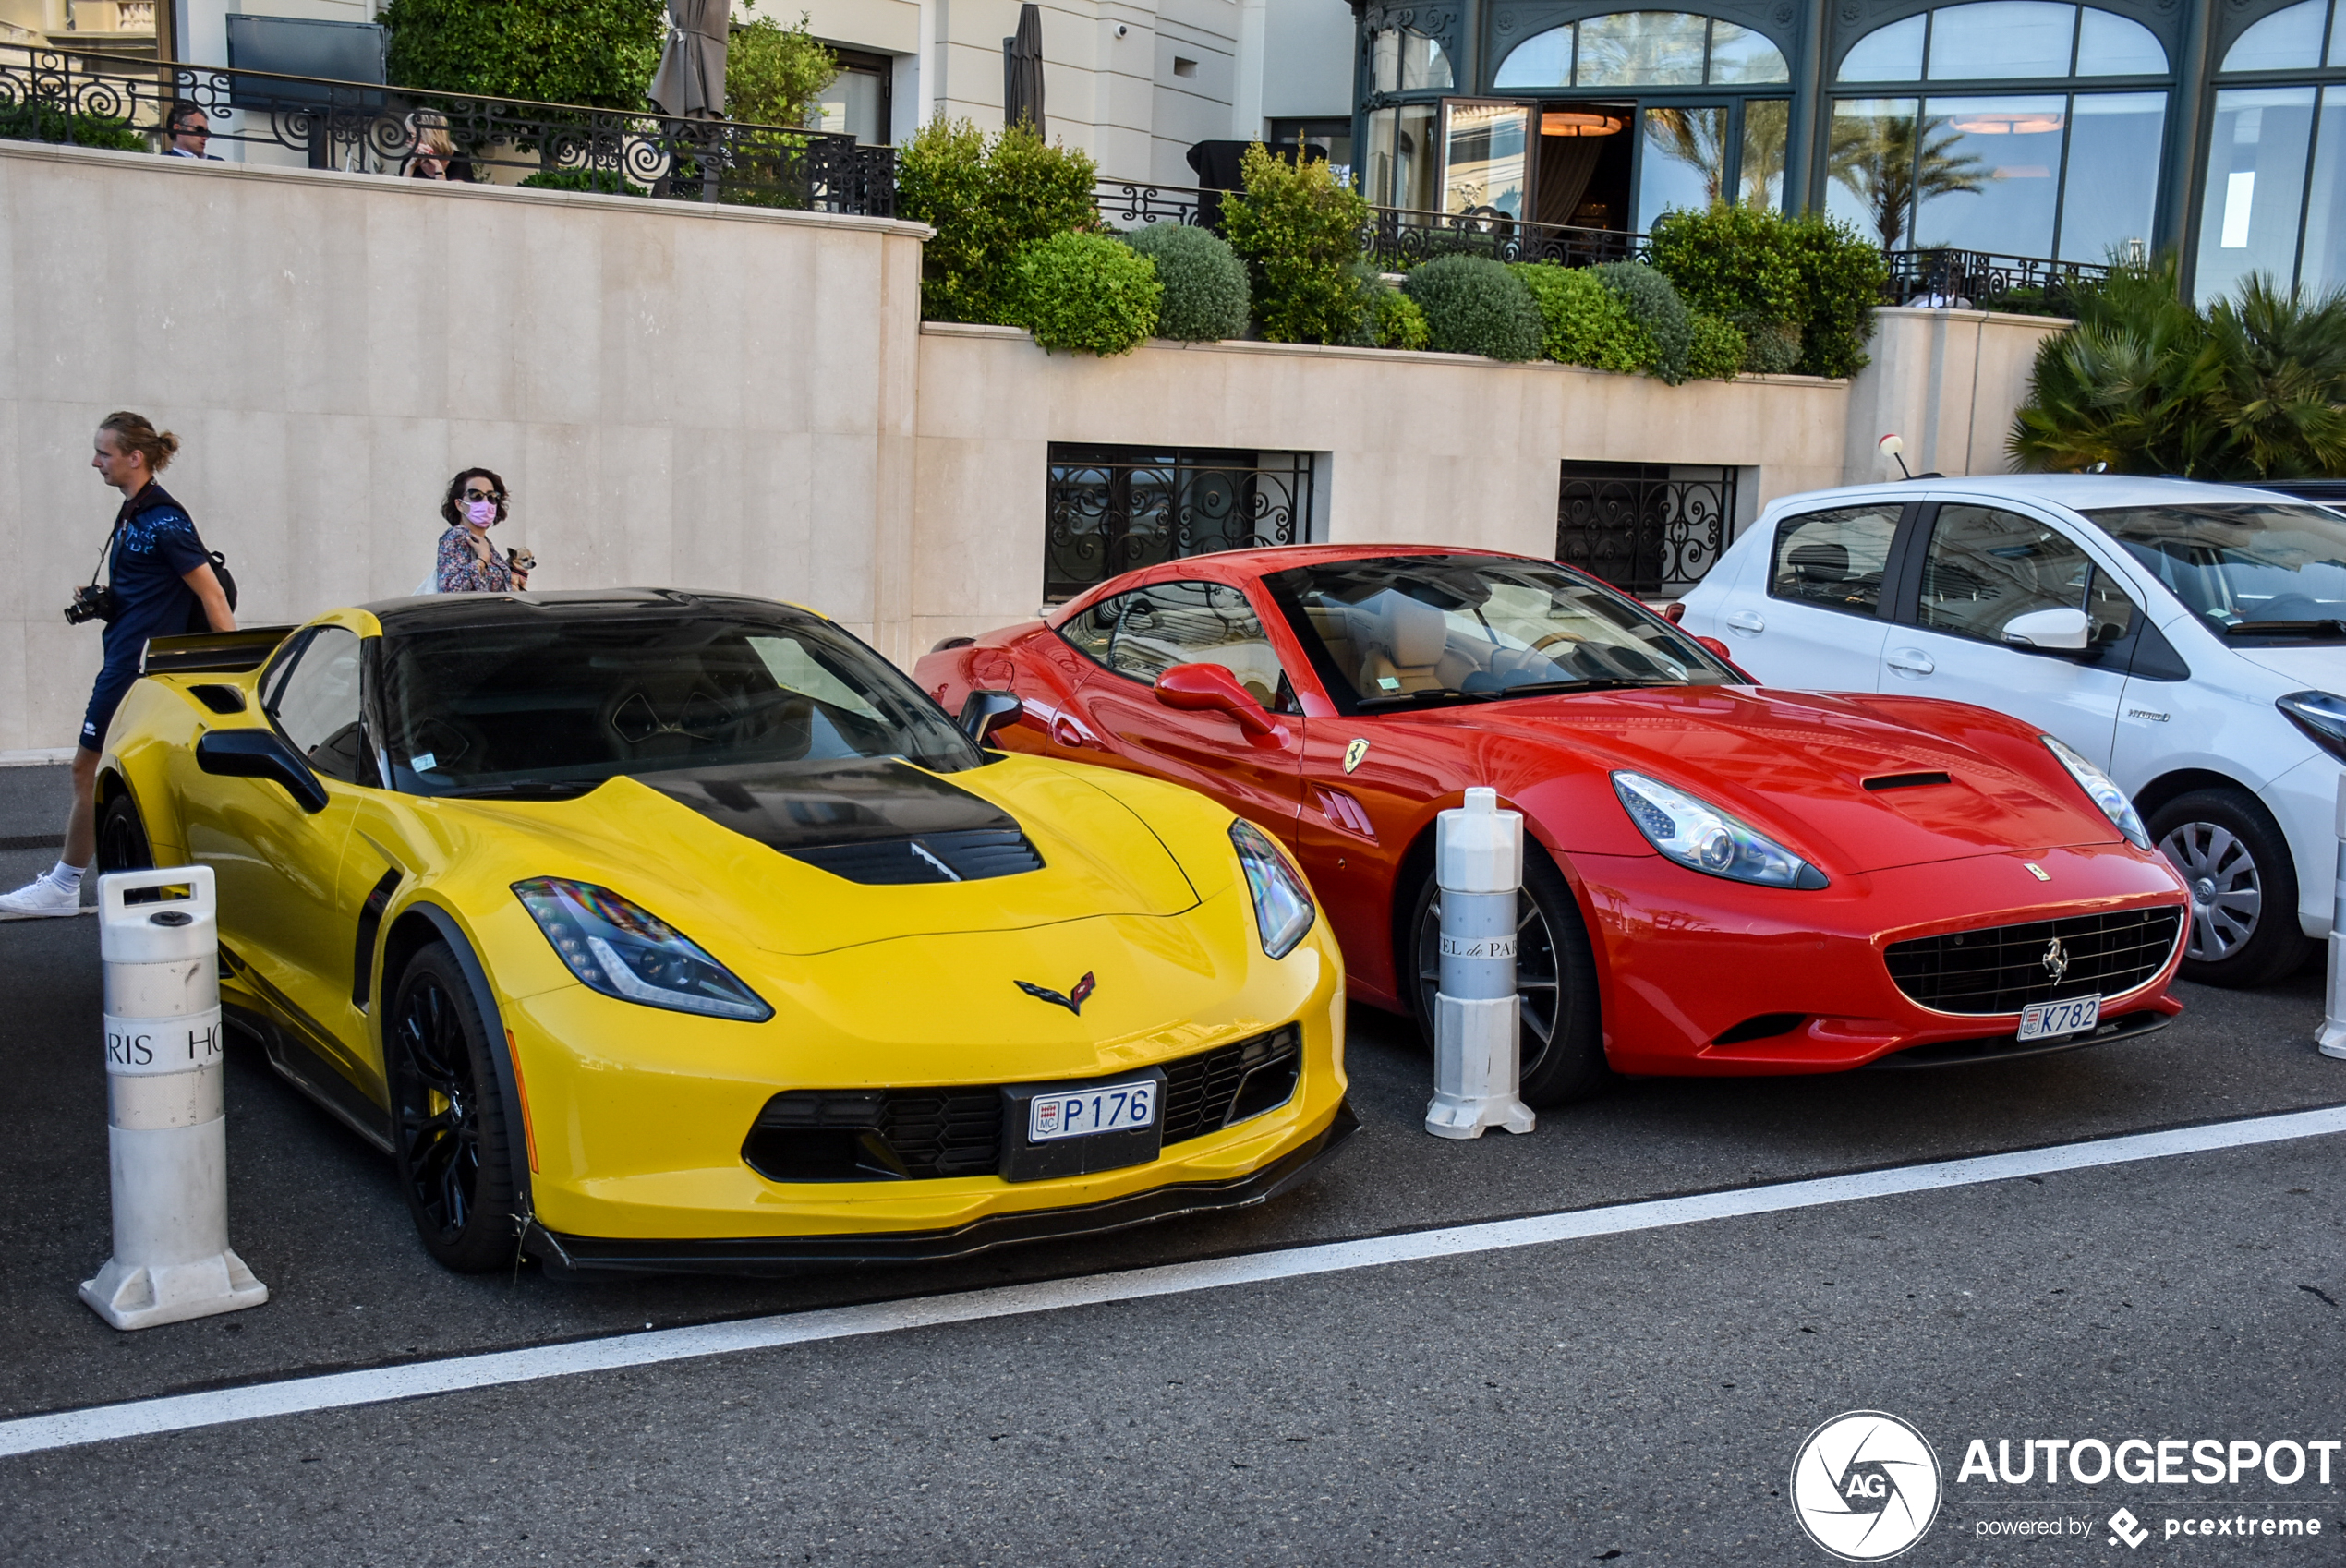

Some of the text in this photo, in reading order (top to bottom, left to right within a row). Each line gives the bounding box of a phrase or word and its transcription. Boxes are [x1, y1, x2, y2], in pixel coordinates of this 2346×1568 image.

[1439, 936, 1461, 956] EL
[1466, 943, 1483, 957] de
[2040, 1000, 2097, 1033] K782
[106, 1032, 153, 1065] RIS
[1040, 1089, 1149, 1131] MC P176
